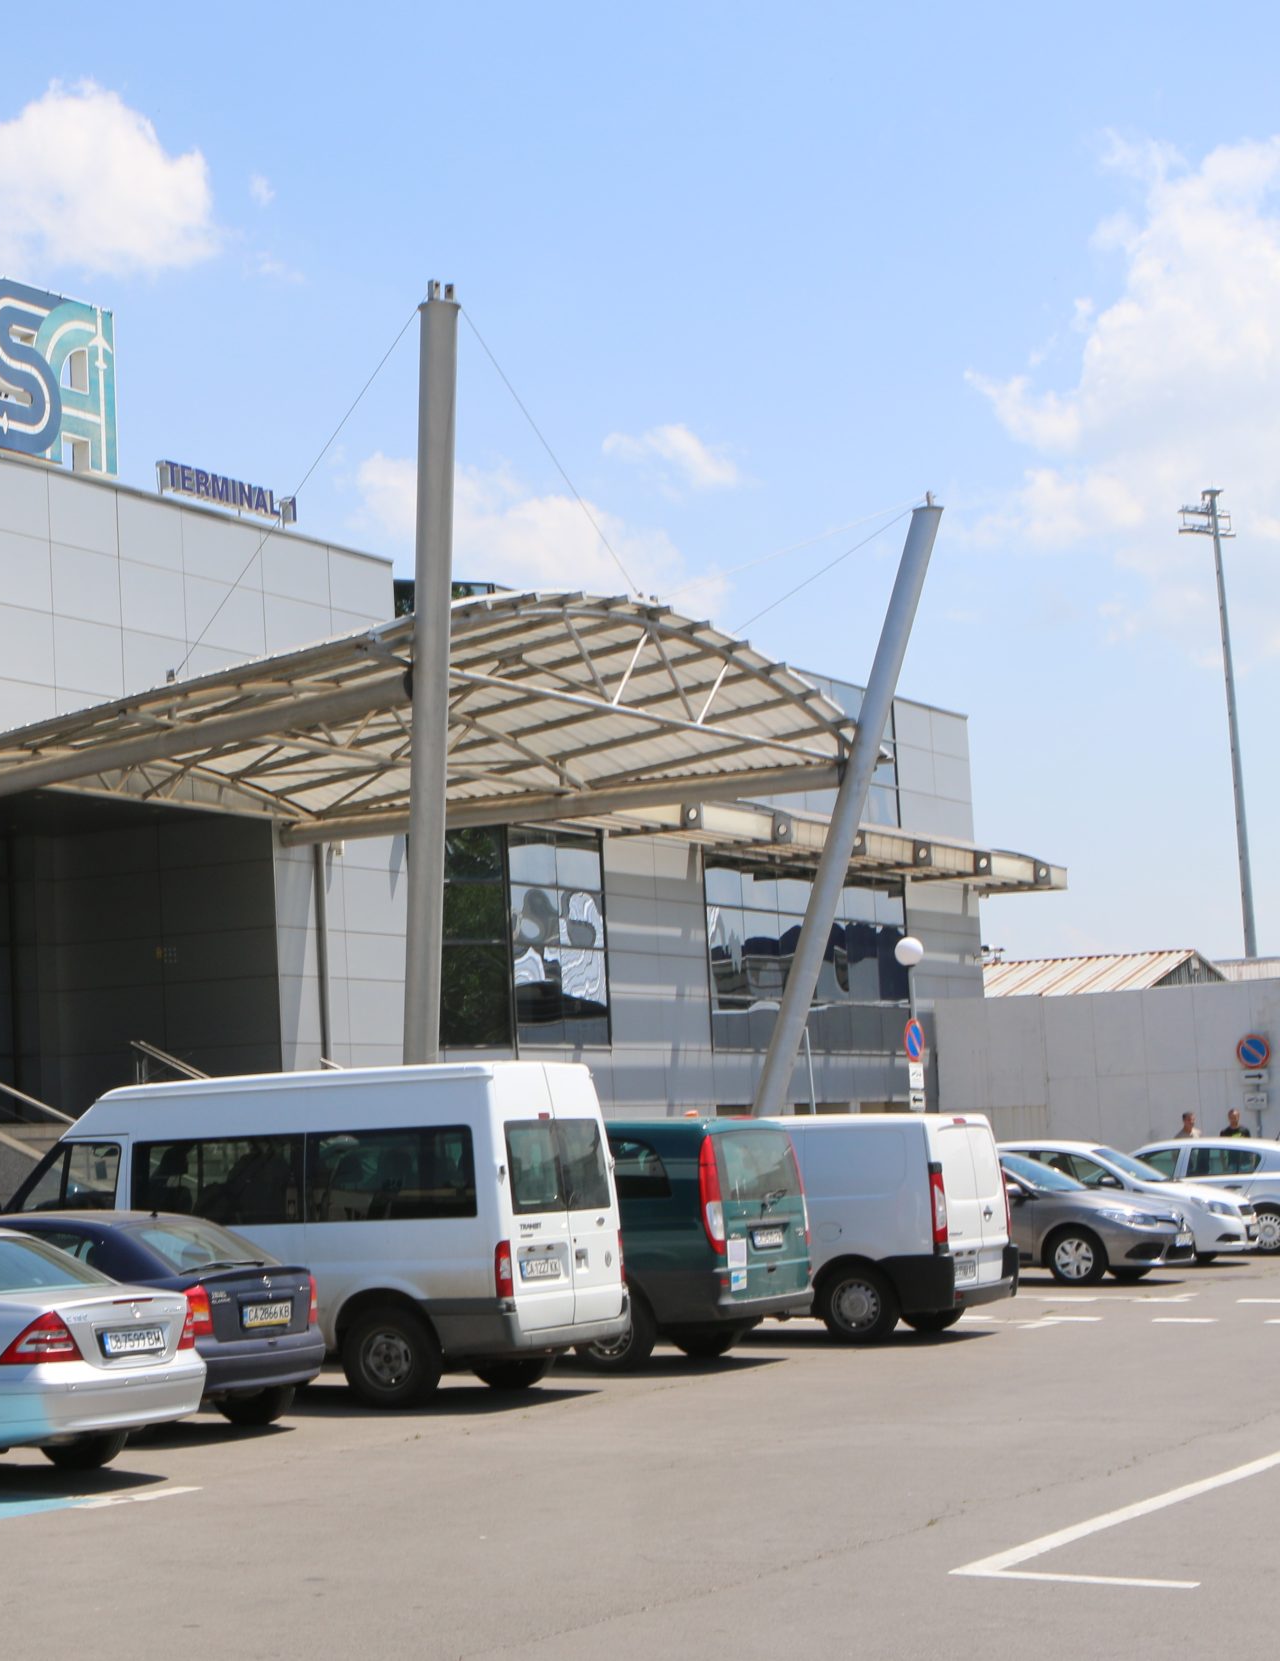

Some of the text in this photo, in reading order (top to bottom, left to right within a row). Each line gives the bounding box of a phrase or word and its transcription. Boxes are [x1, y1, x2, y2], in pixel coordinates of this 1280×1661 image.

[161, 459, 281, 518] TERMINAL
[248, 1305, 290, 1322] CA 2866 KB
[122, 1331, 146, 1349] 7599
